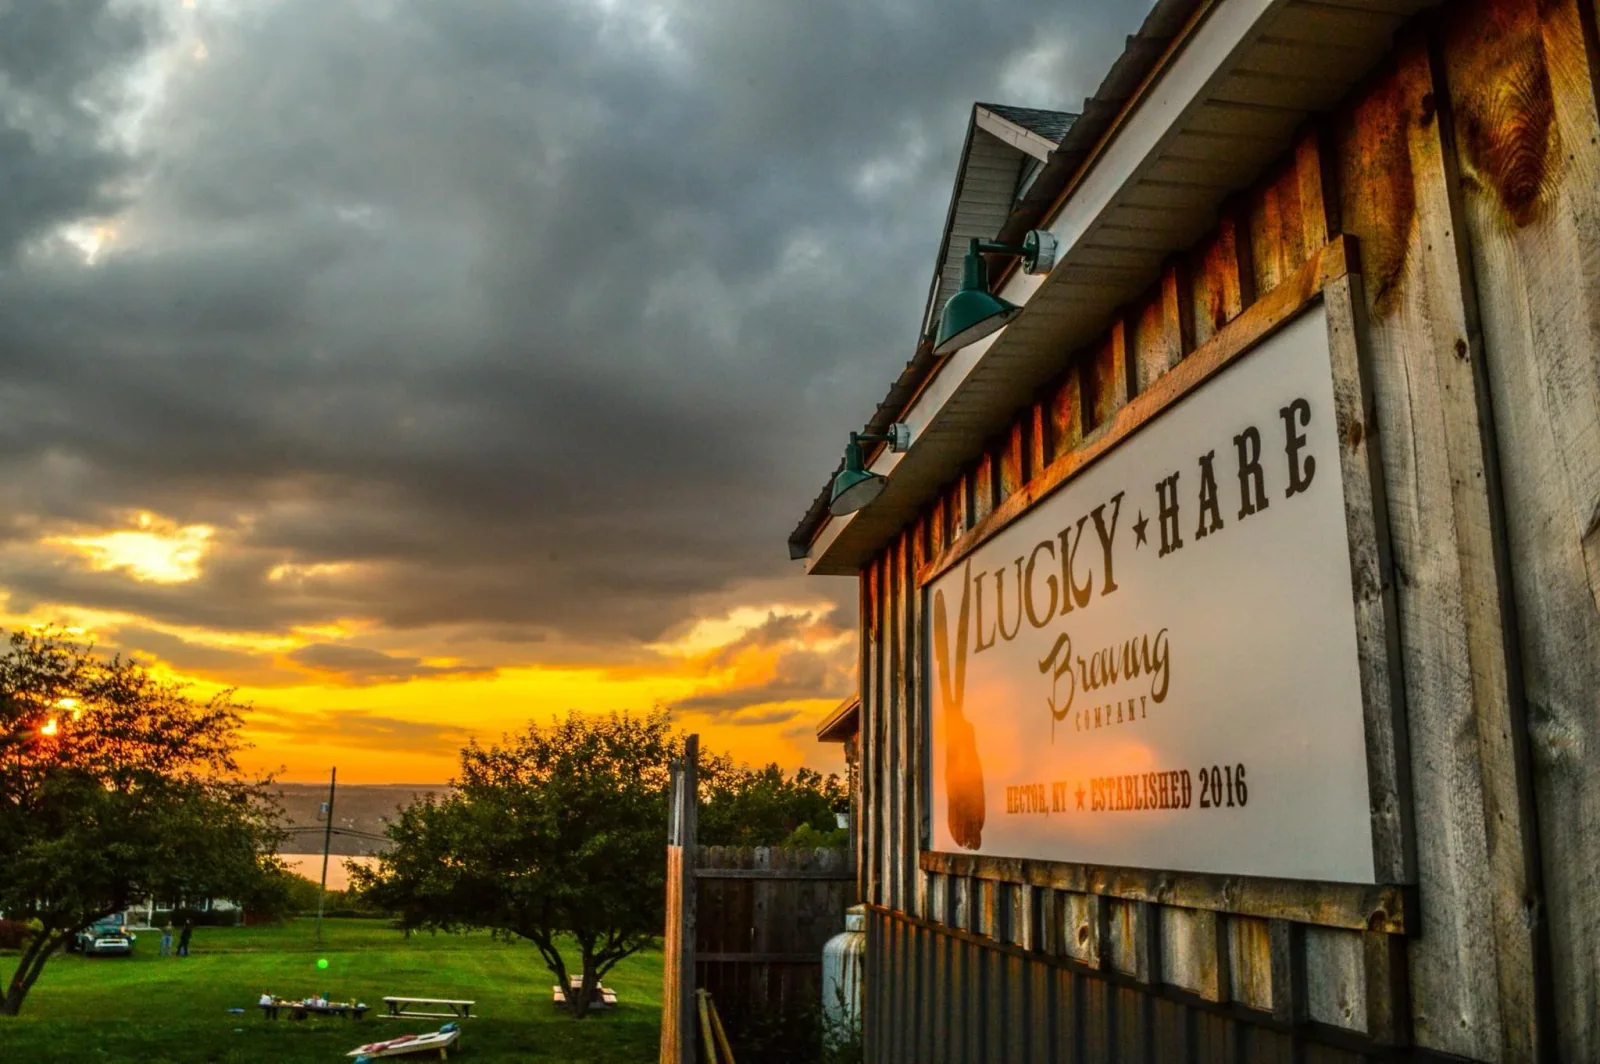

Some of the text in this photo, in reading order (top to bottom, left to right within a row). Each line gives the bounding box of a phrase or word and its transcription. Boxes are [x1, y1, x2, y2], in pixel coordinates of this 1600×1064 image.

[973, 397, 1317, 654] LUCKY HARE
[1038, 627, 1170, 745] Brewing
[1075, 695, 1148, 732] COMPANY
[1006, 762, 1249, 817] HECTOR, NY ESTABLISHED 2016
